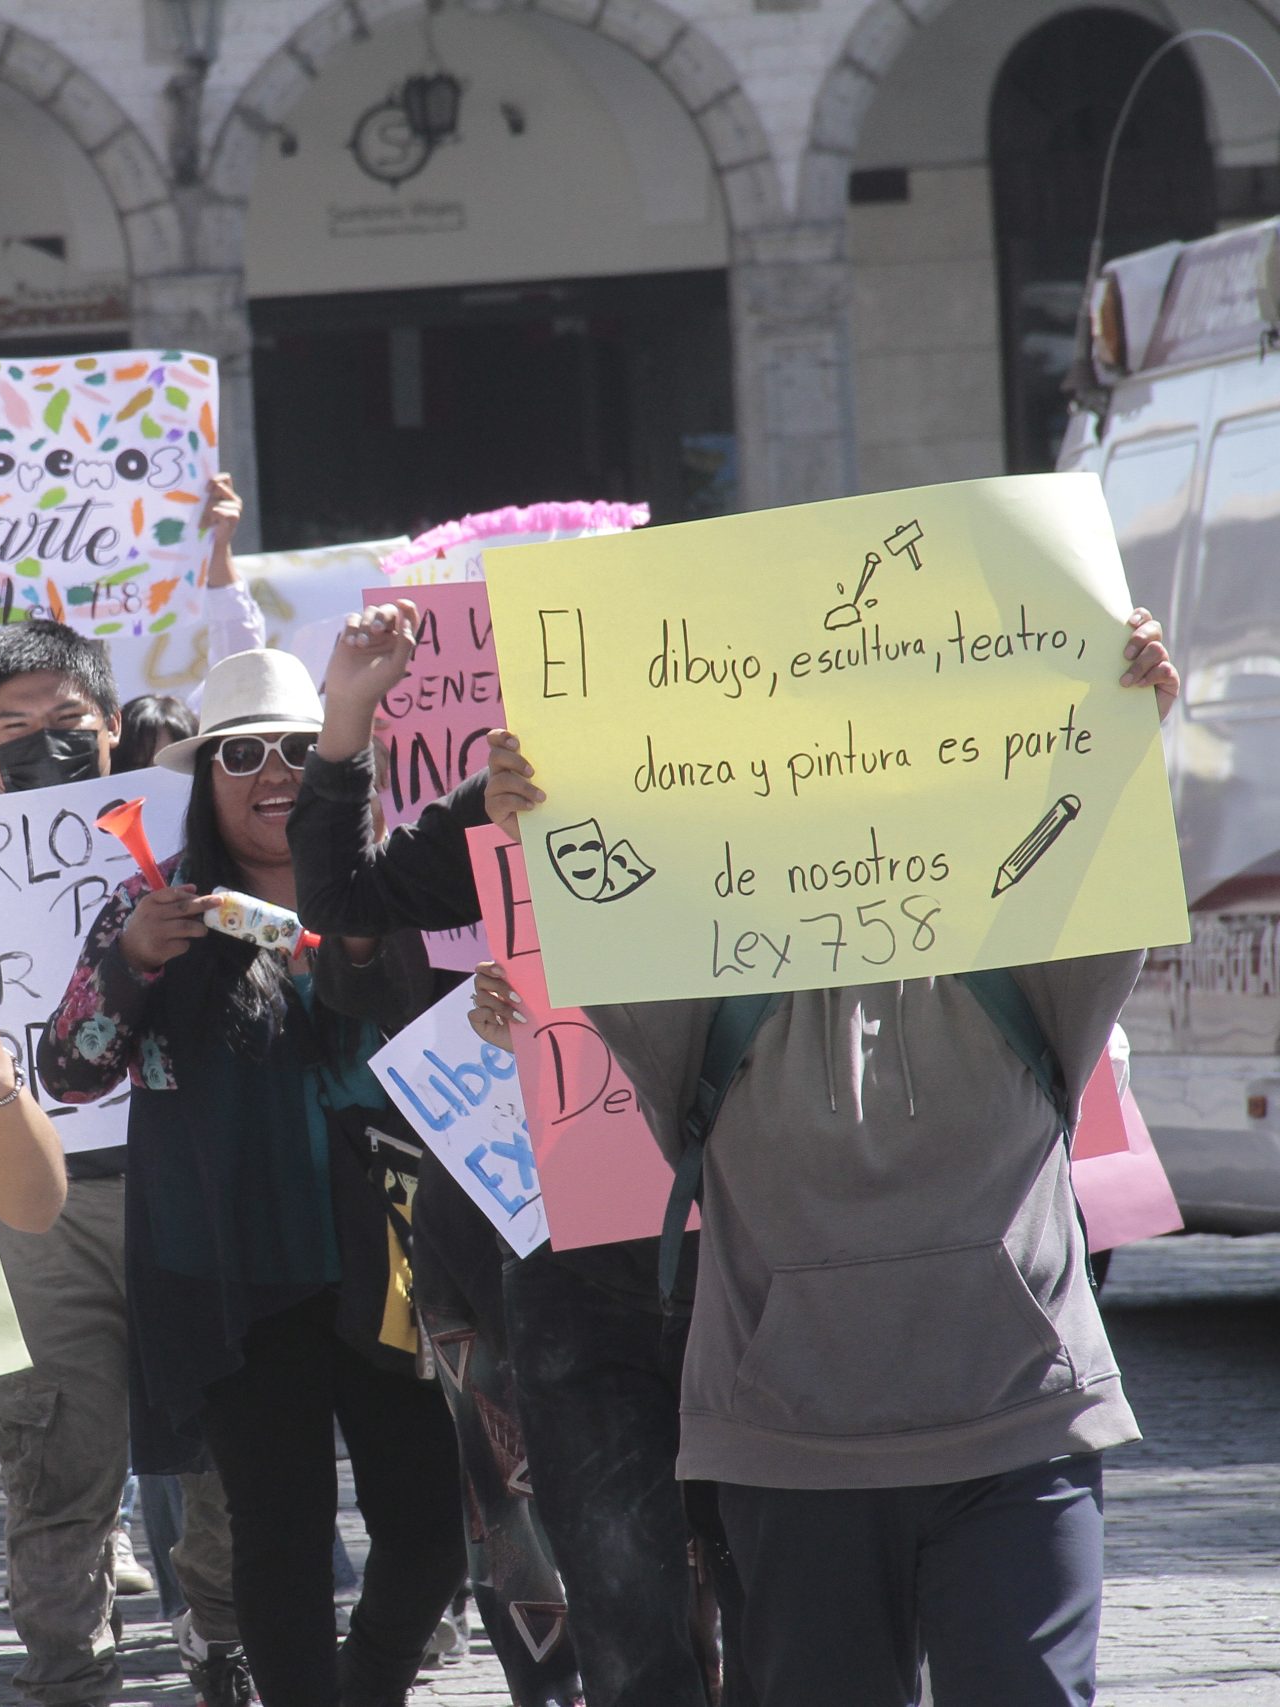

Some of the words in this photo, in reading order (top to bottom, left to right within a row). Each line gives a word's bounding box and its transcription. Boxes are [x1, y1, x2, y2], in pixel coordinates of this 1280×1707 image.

[79, 581, 143, 620] 758
[539, 608, 587, 698] El
[634, 735, 737, 793] danza
[754, 755, 771, 797] y
[787, 720, 912, 797] pintura
[938, 739, 980, 766] es
[1004, 704, 1094, 780] parte
[714, 841, 756, 898] de
[788, 826, 951, 893] nosotros
[799, 895, 942, 972] 758
[464, 1118, 536, 1216] EX
